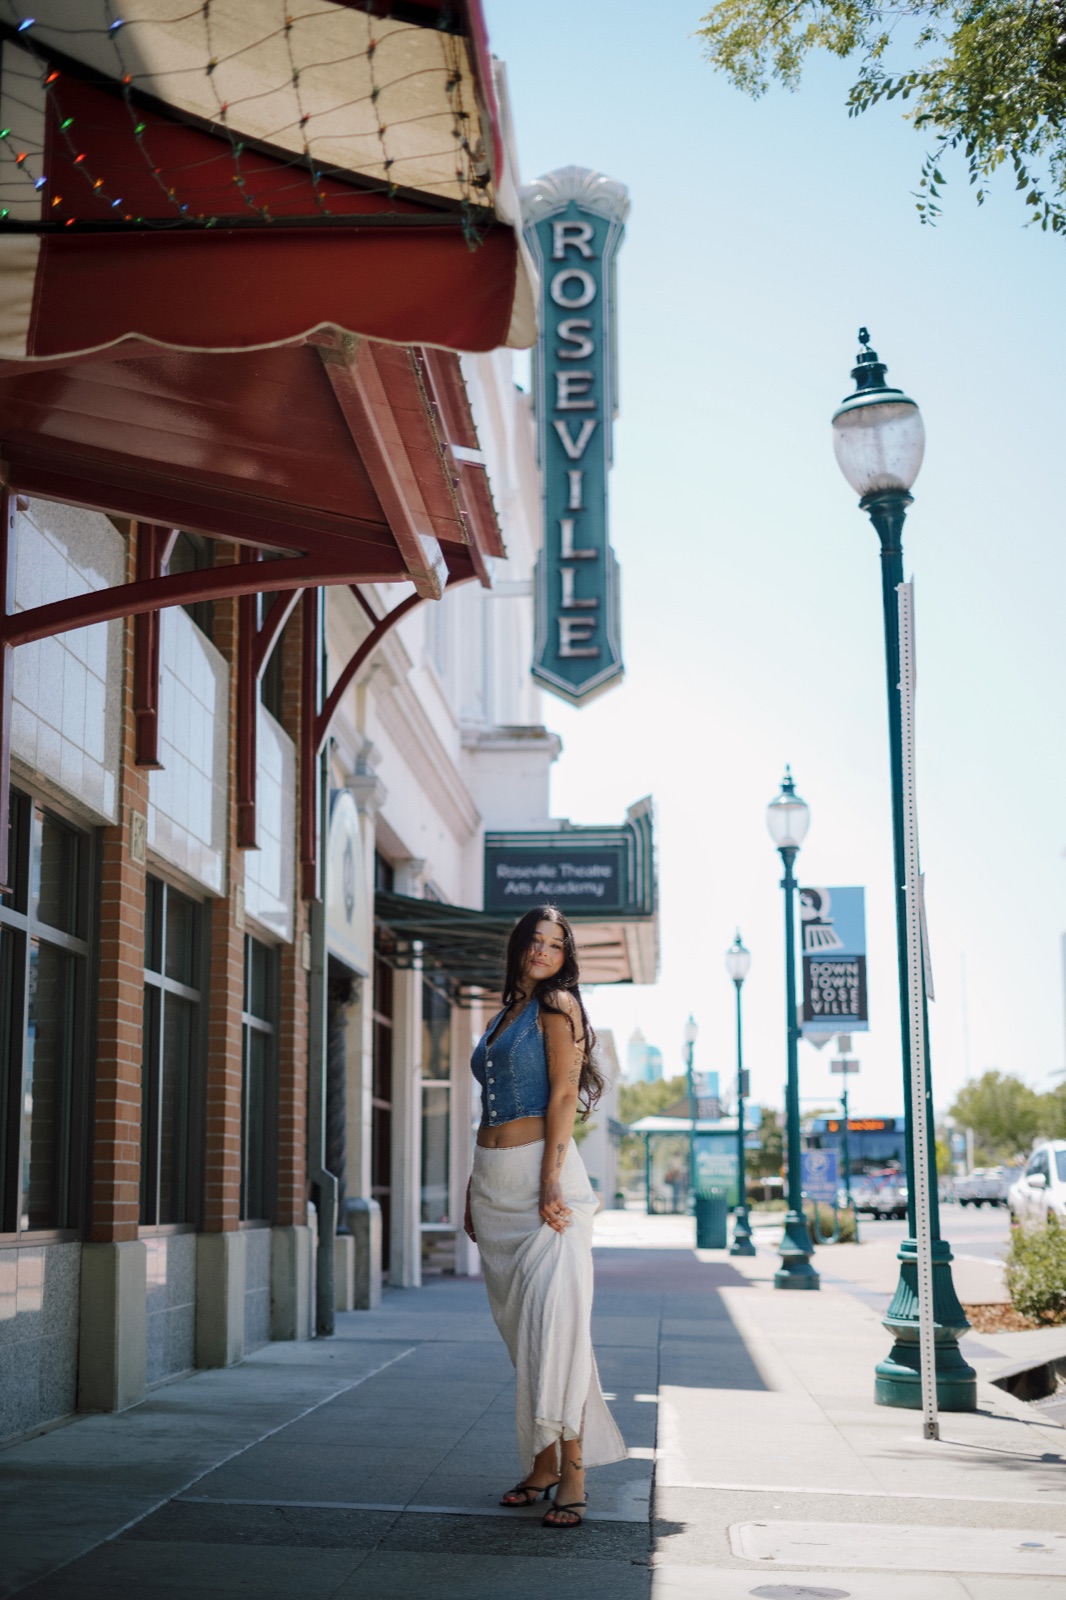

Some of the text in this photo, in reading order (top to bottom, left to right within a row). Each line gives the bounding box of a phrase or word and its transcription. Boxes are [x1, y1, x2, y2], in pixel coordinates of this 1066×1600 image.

[550, 220, 598, 657] ROSEVILLE
[497, 863, 611, 878] Roseville Theatre
[505, 881, 604, 896] Arts Academy
[810, 962, 859, 975] DOWN
[811, 975, 859, 988] TOWN
[811, 988, 859, 1001] ROSE
[811, 1001, 859, 1014] VILLE
